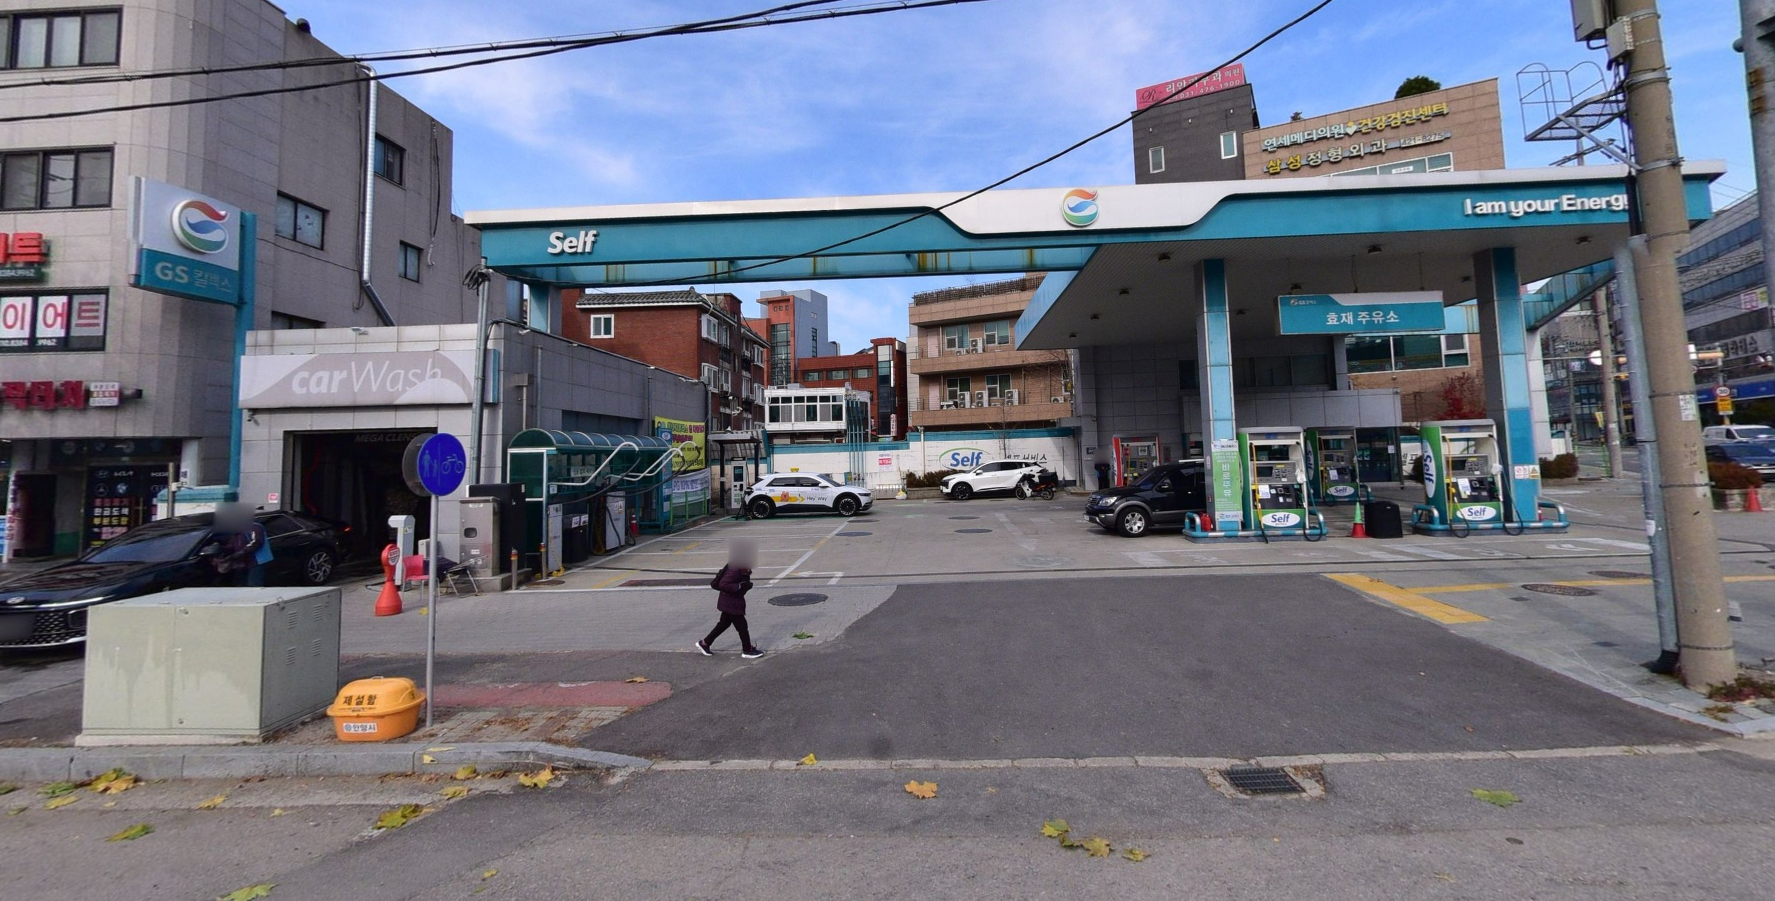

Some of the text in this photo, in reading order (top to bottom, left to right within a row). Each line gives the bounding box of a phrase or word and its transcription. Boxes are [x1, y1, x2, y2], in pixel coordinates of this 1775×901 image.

[1263, 102, 1448, 151] 연세메디의원 건강검진센터
[1474, 201, 1507, 214] am
[1510, 199, 1559, 217] your
[547, 230, 597, 254] Self
[155, 261, 232, 293] GS 칼텍스
[1326, 311, 1400, 325] 효재 주유소
[355, 433, 384, 442] MEGA
[949, 451, 983, 468] Self
[1423, 454, 1435, 484] Self
[1334, 486, 1348, 494] Self
[1271, 513, 1291, 523] Self
[1467, 507, 1488, 517] Self
[343, 694, 377, 706] 제설함
